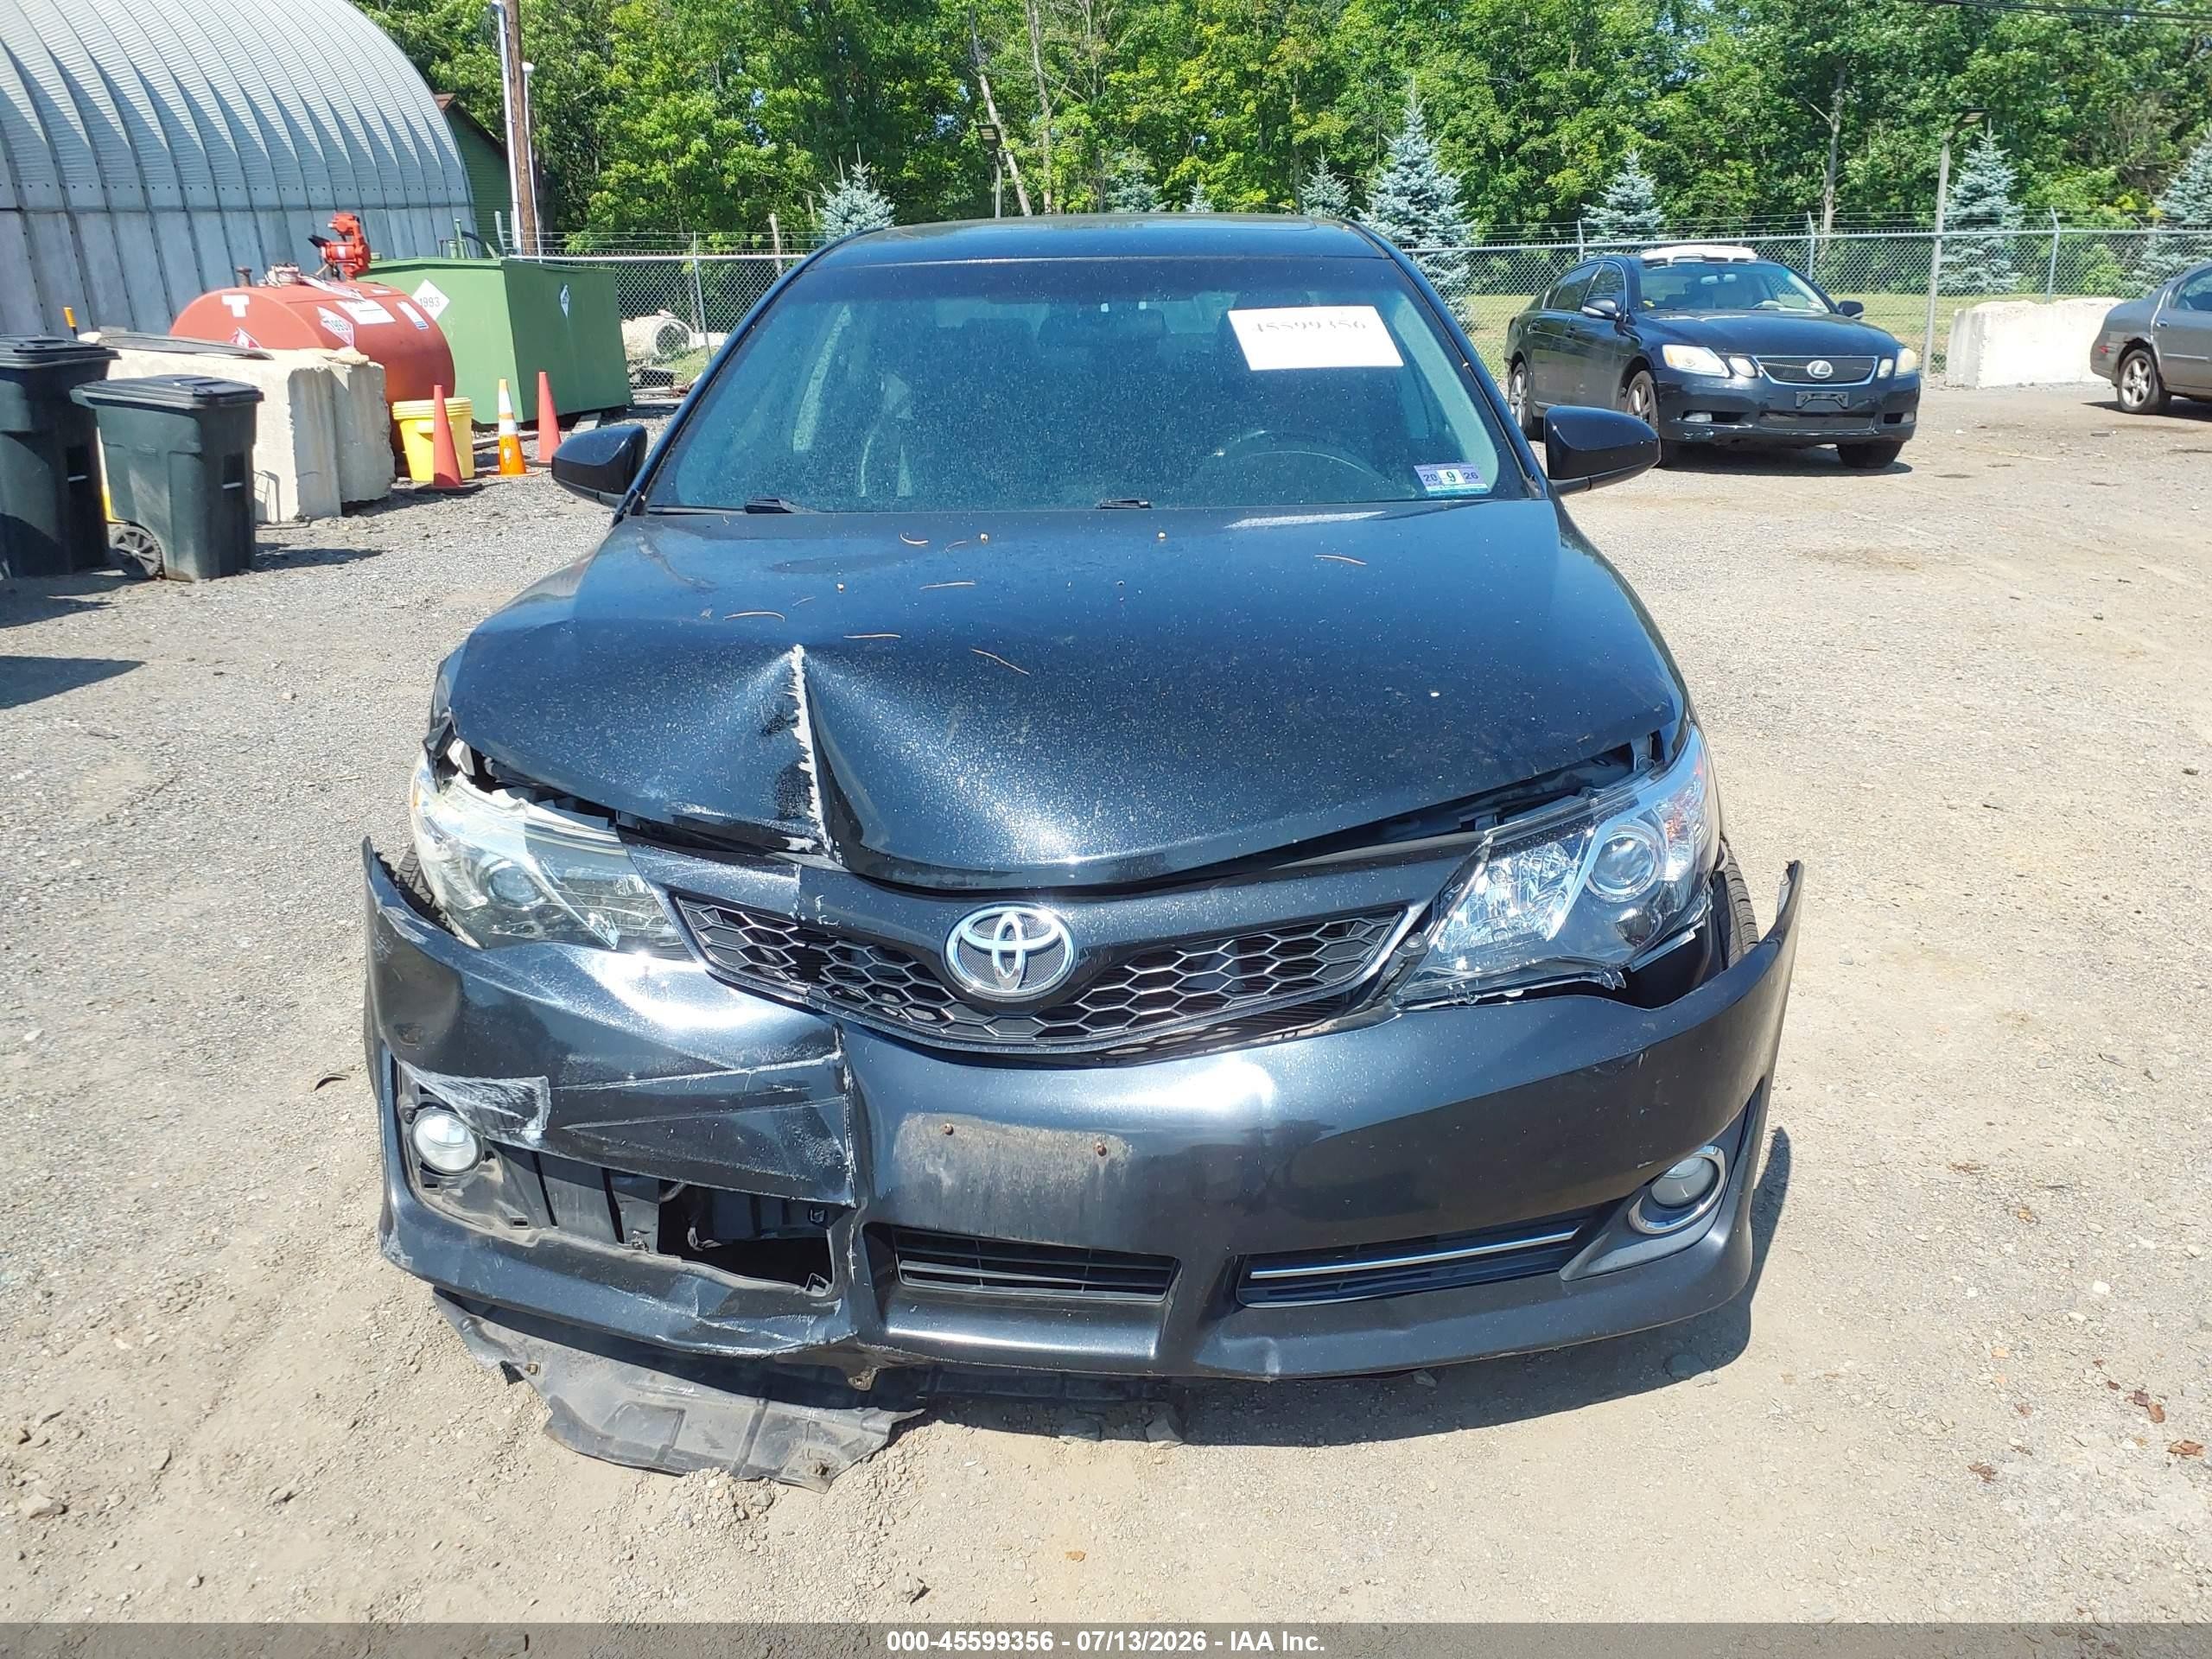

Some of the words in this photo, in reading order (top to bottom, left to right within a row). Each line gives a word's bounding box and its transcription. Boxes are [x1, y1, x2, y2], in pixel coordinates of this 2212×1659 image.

[419, 296, 441, 308] 1993
[1423, 474, 1439, 482] 20
[1446, 471, 1456, 482] 9
